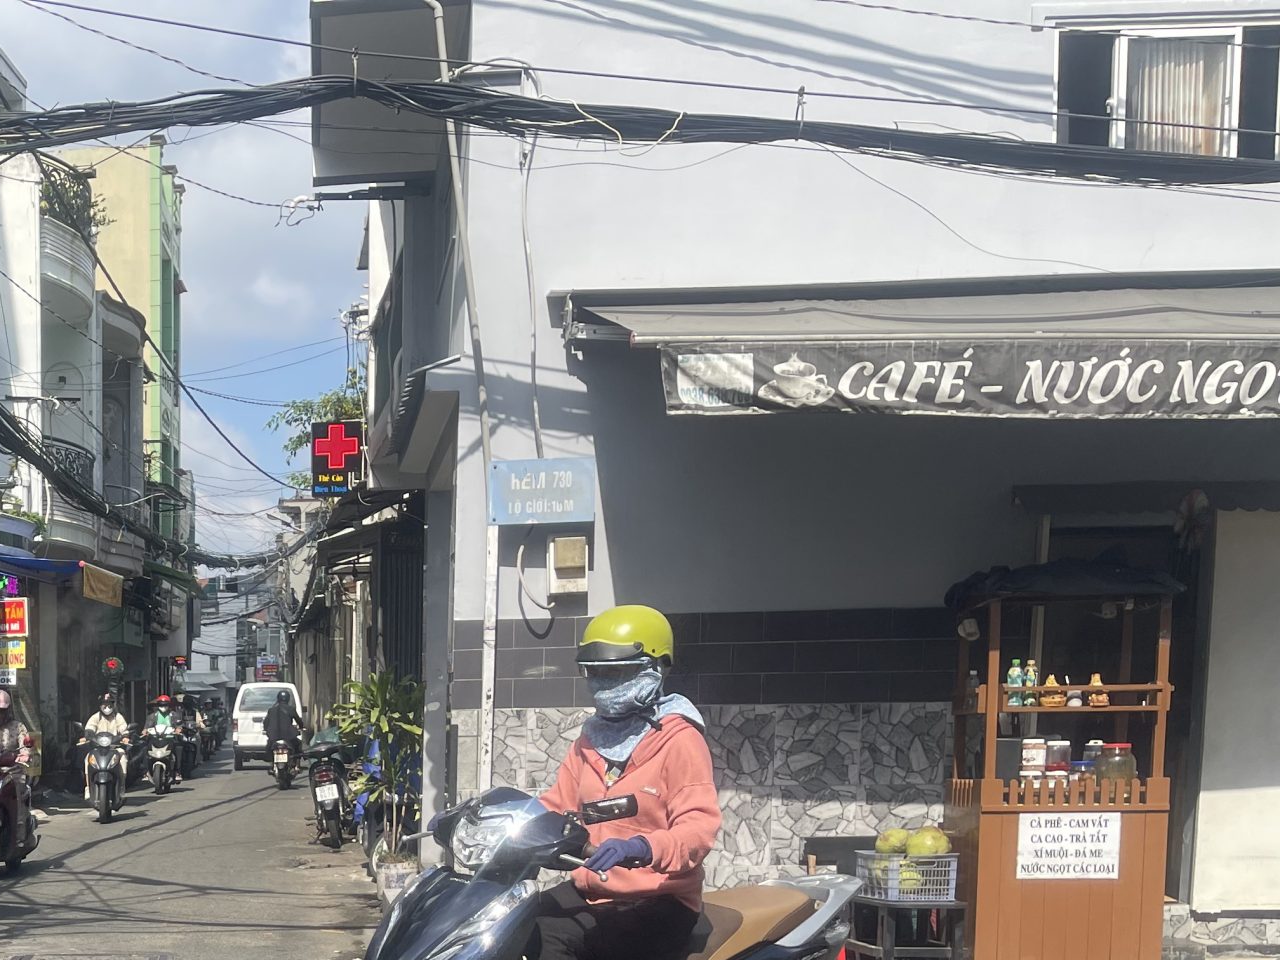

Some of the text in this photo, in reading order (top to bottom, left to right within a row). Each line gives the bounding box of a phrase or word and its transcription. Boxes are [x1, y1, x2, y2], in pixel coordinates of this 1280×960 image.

[838, 348, 973, 403] CAFÉ
[1016, 347, 1164, 404] NƯỚC
[1169, 360, 1280, 413] NGỌ
[552, 471, 573, 489] 730
[1044, 816, 1062, 828] PHÊ
[1069, 818, 1089, 828] CAM
[1031, 834, 1043, 843] CA
[1045, 834, 1063, 843] CAO
[1033, 846, 1043, 858] XÍ
[1045, 846, 1068, 860] MUỘI
[1090, 849, 1103, 858] ME
[1020, 861, 1115, 875] NƯỚC NGỌT CÁC LOẠI
